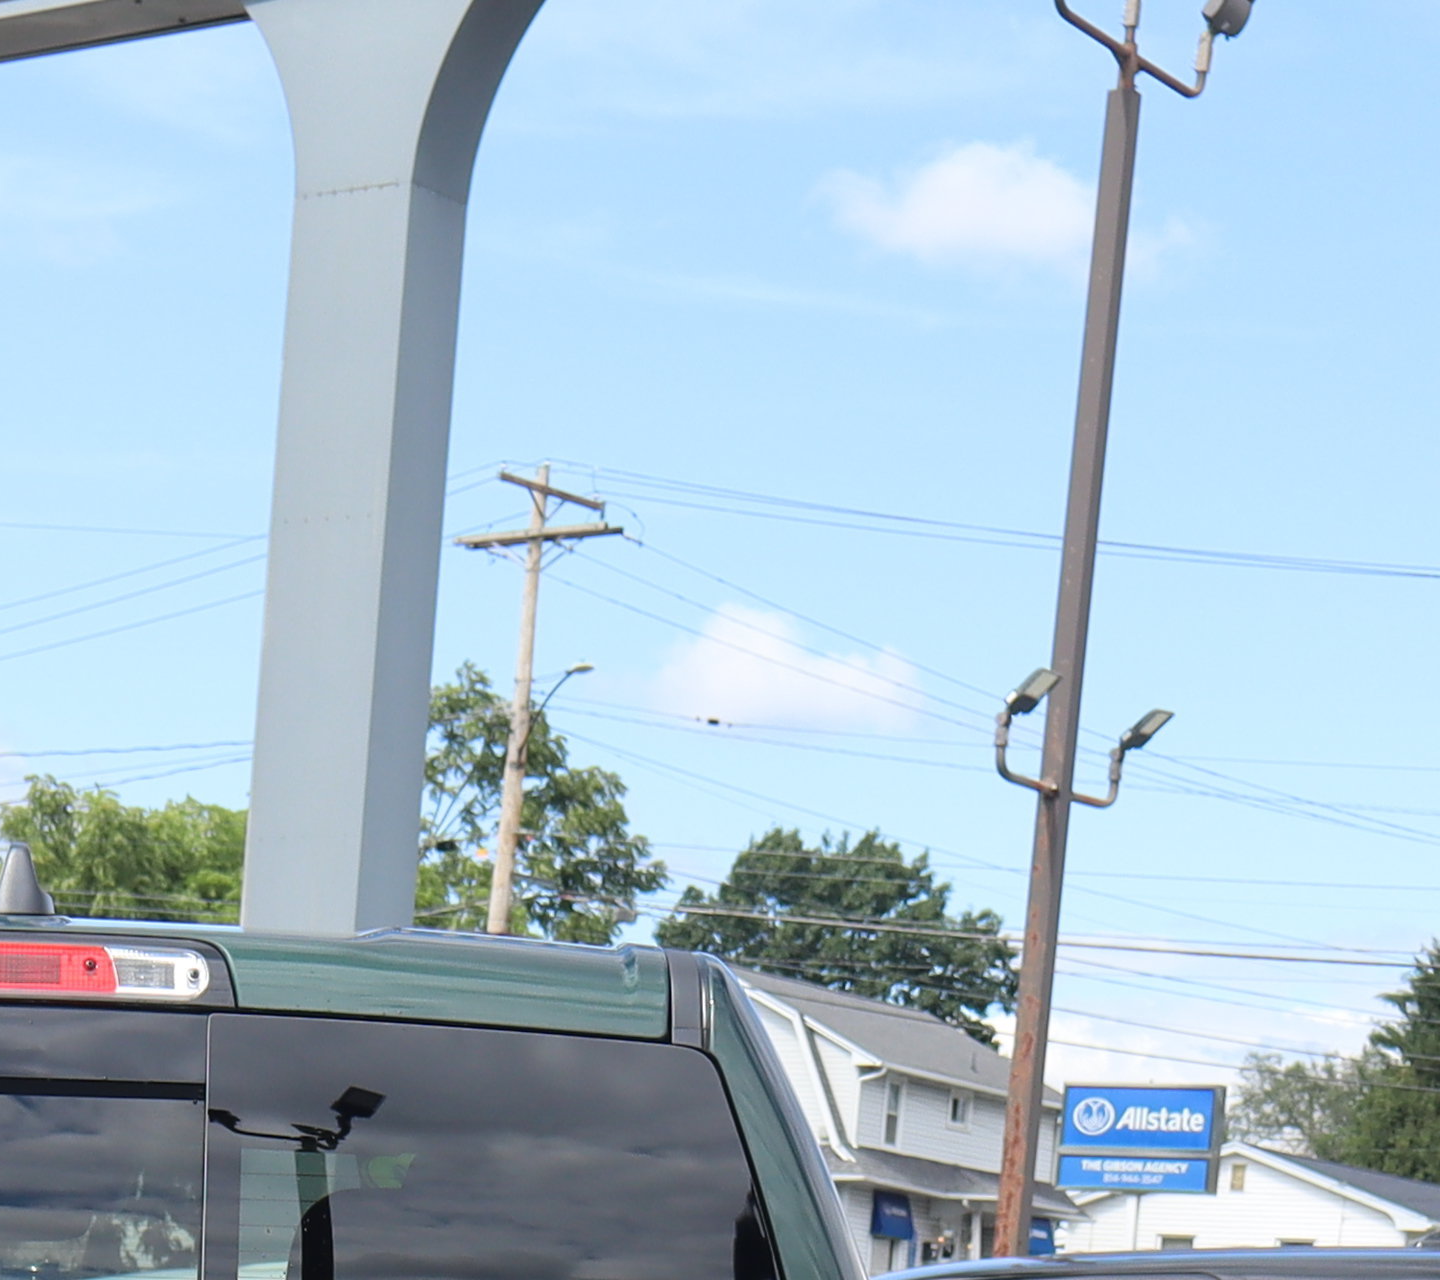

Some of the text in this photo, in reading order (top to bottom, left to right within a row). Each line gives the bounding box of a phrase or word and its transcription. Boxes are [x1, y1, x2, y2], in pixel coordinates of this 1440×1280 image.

[1116, 1106, 1205, 1132] Allstate
[1081, 1159, 1102, 1171] THE
[1143, 1160, 1189, 1174] AGENCY
